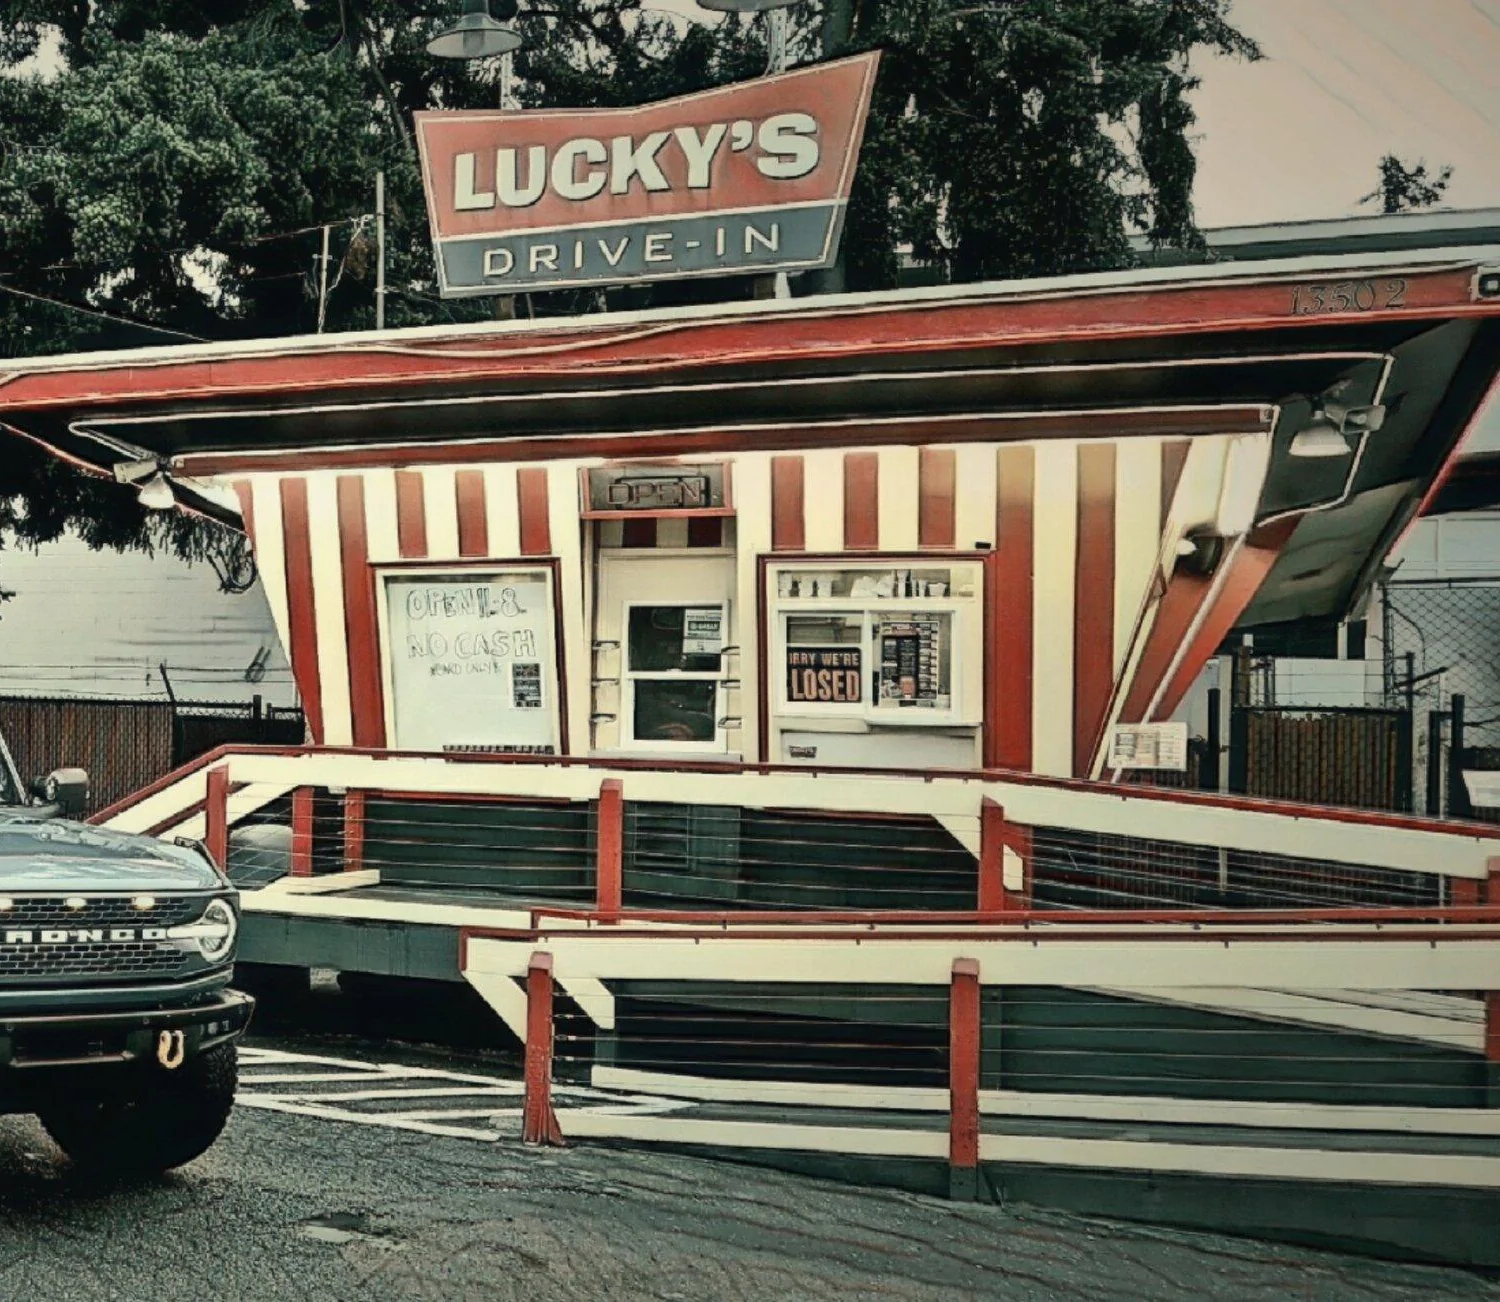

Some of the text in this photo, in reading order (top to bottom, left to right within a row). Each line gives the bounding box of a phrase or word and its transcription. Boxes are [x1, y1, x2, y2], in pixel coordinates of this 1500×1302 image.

[454, 112, 820, 212] LUCKY'S
[482, 222, 779, 277] DRIVE-IN
[1289, 280, 1406, 315] 13502
[607, 478, 702, 505] OPEN
[406, 588, 474, 620] OPEN
[406, 629, 537, 660] NO CASH
[791, 668, 860, 701] LOSED
